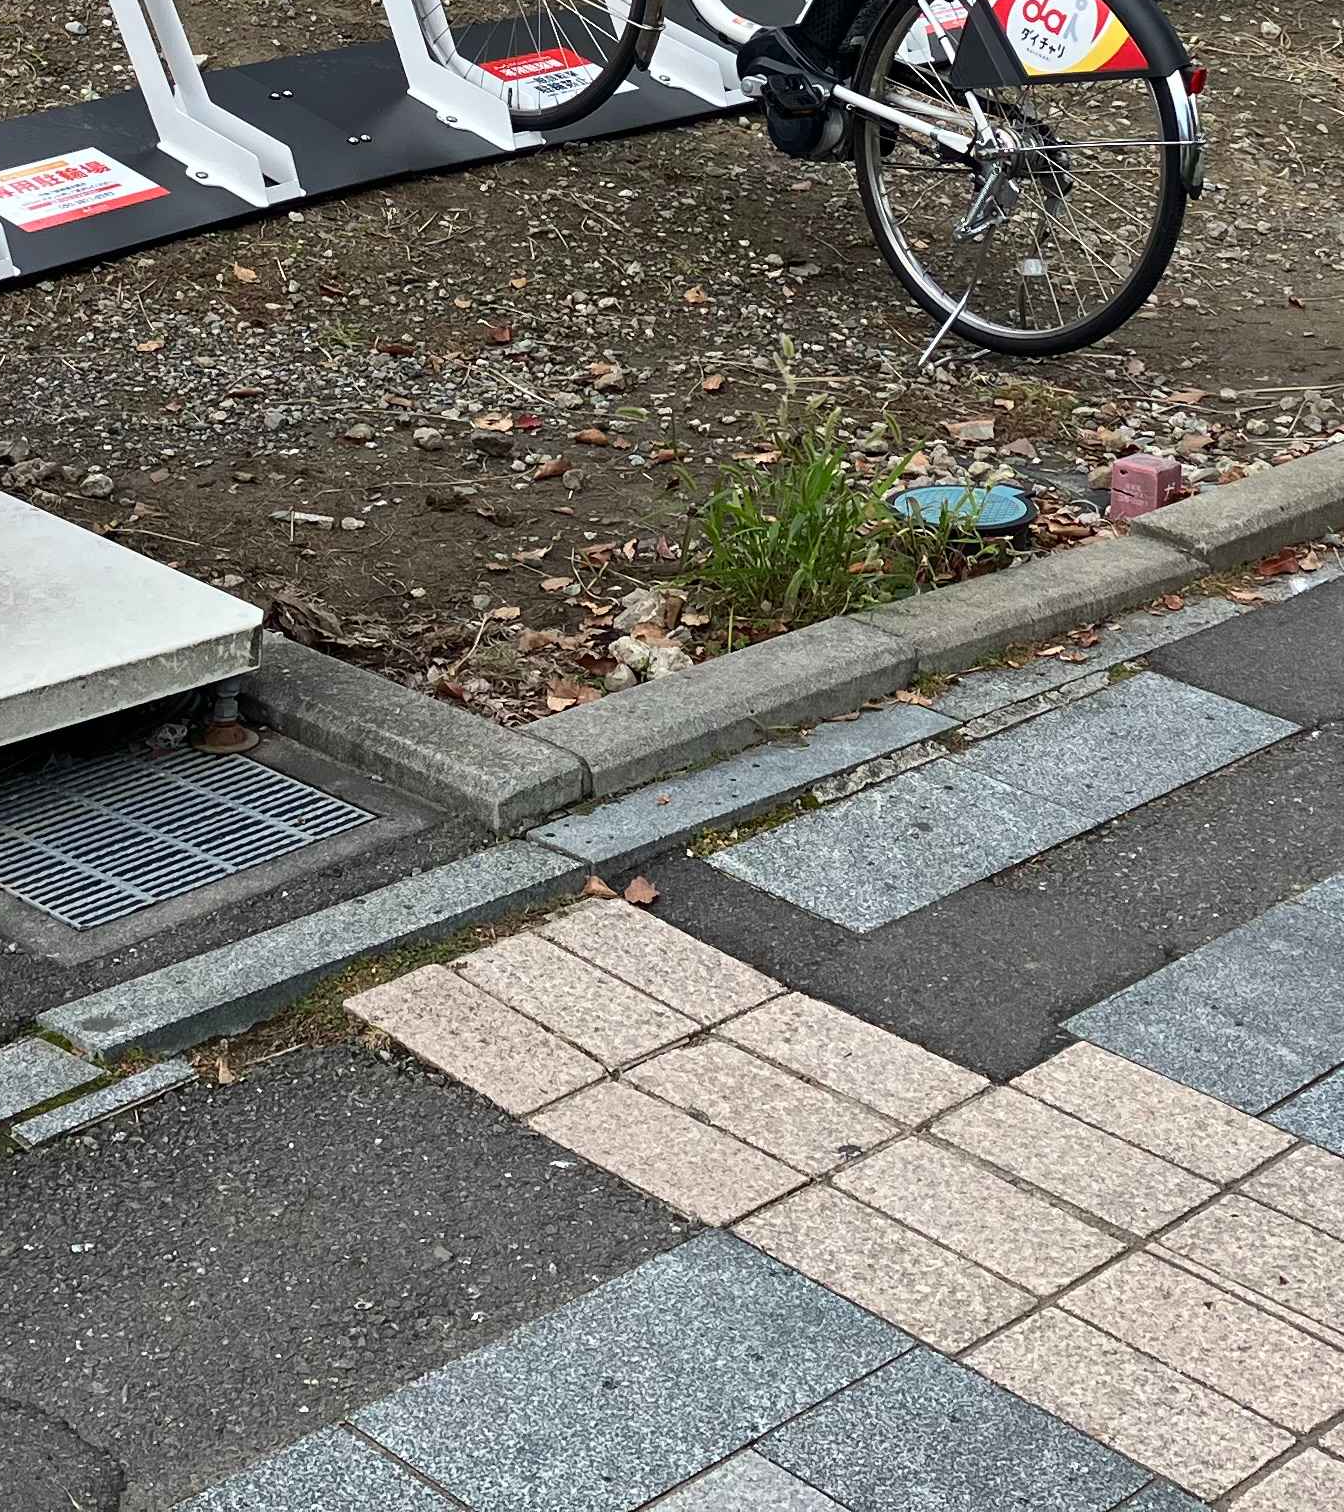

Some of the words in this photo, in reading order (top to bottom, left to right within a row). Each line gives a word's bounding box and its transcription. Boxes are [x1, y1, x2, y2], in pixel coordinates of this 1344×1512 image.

[1020, 28, 1066, 59] ダイチャリ
